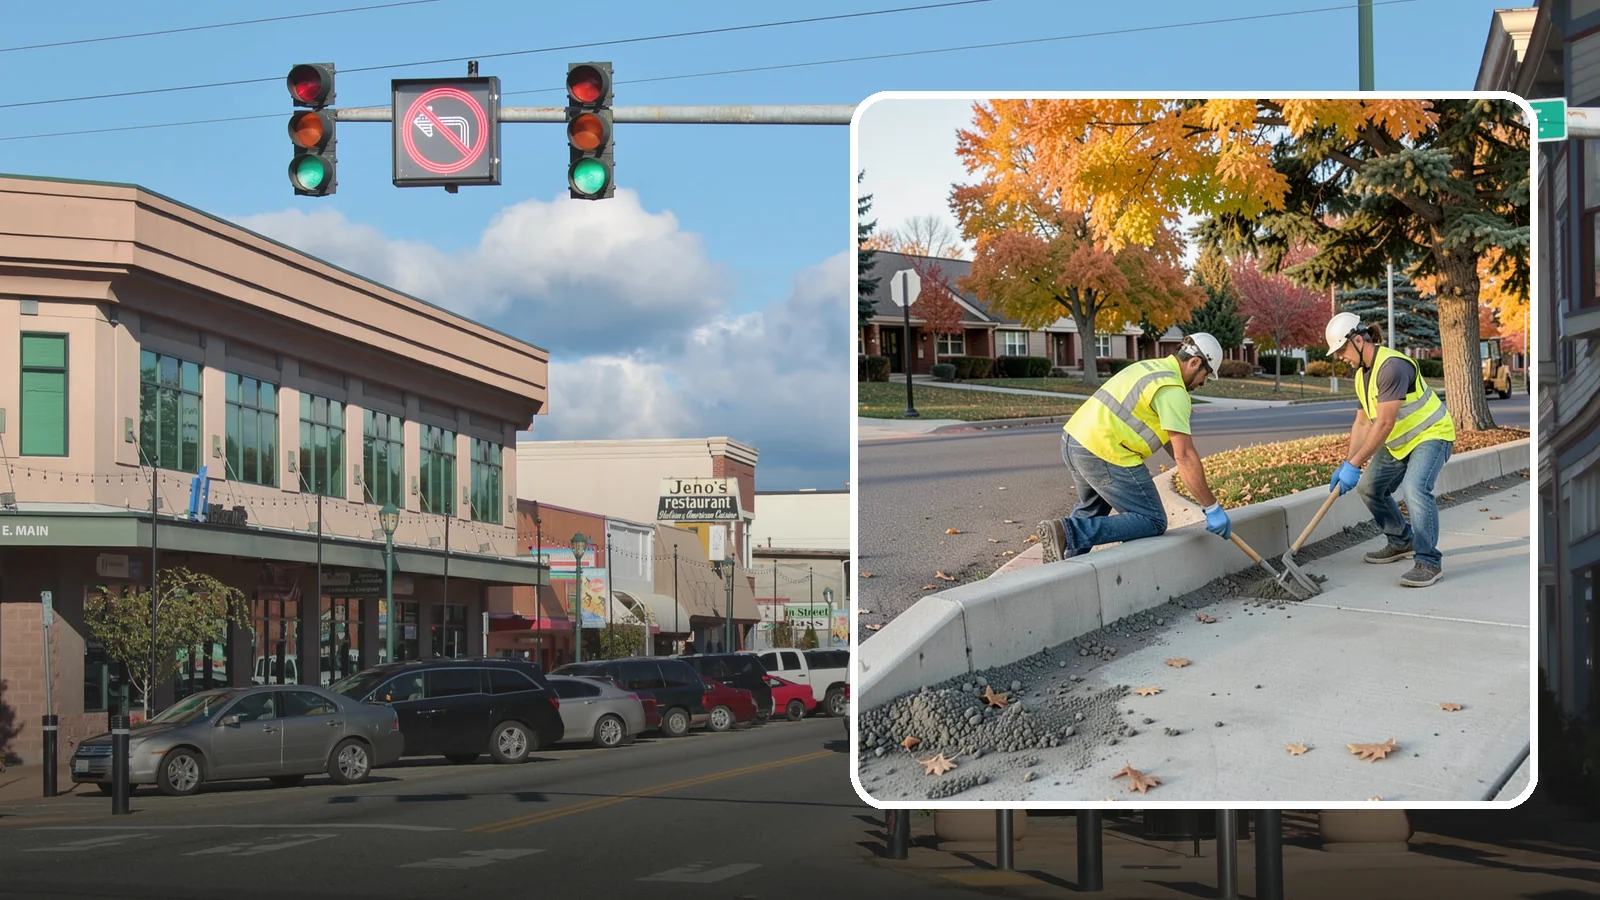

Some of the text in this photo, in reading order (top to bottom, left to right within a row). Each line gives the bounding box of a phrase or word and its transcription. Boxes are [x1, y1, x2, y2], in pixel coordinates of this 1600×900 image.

[669, 480, 728, 495] Jeno's
[665, 496, 731, 509] restaurant
[658, 510, 681, 520] Italian
[686, 509, 715, 519] American
[715, 509, 738, 519] Cuisine
[2, 525, 49, 536] E. MAIN
[797, 607, 829, 617] Street
